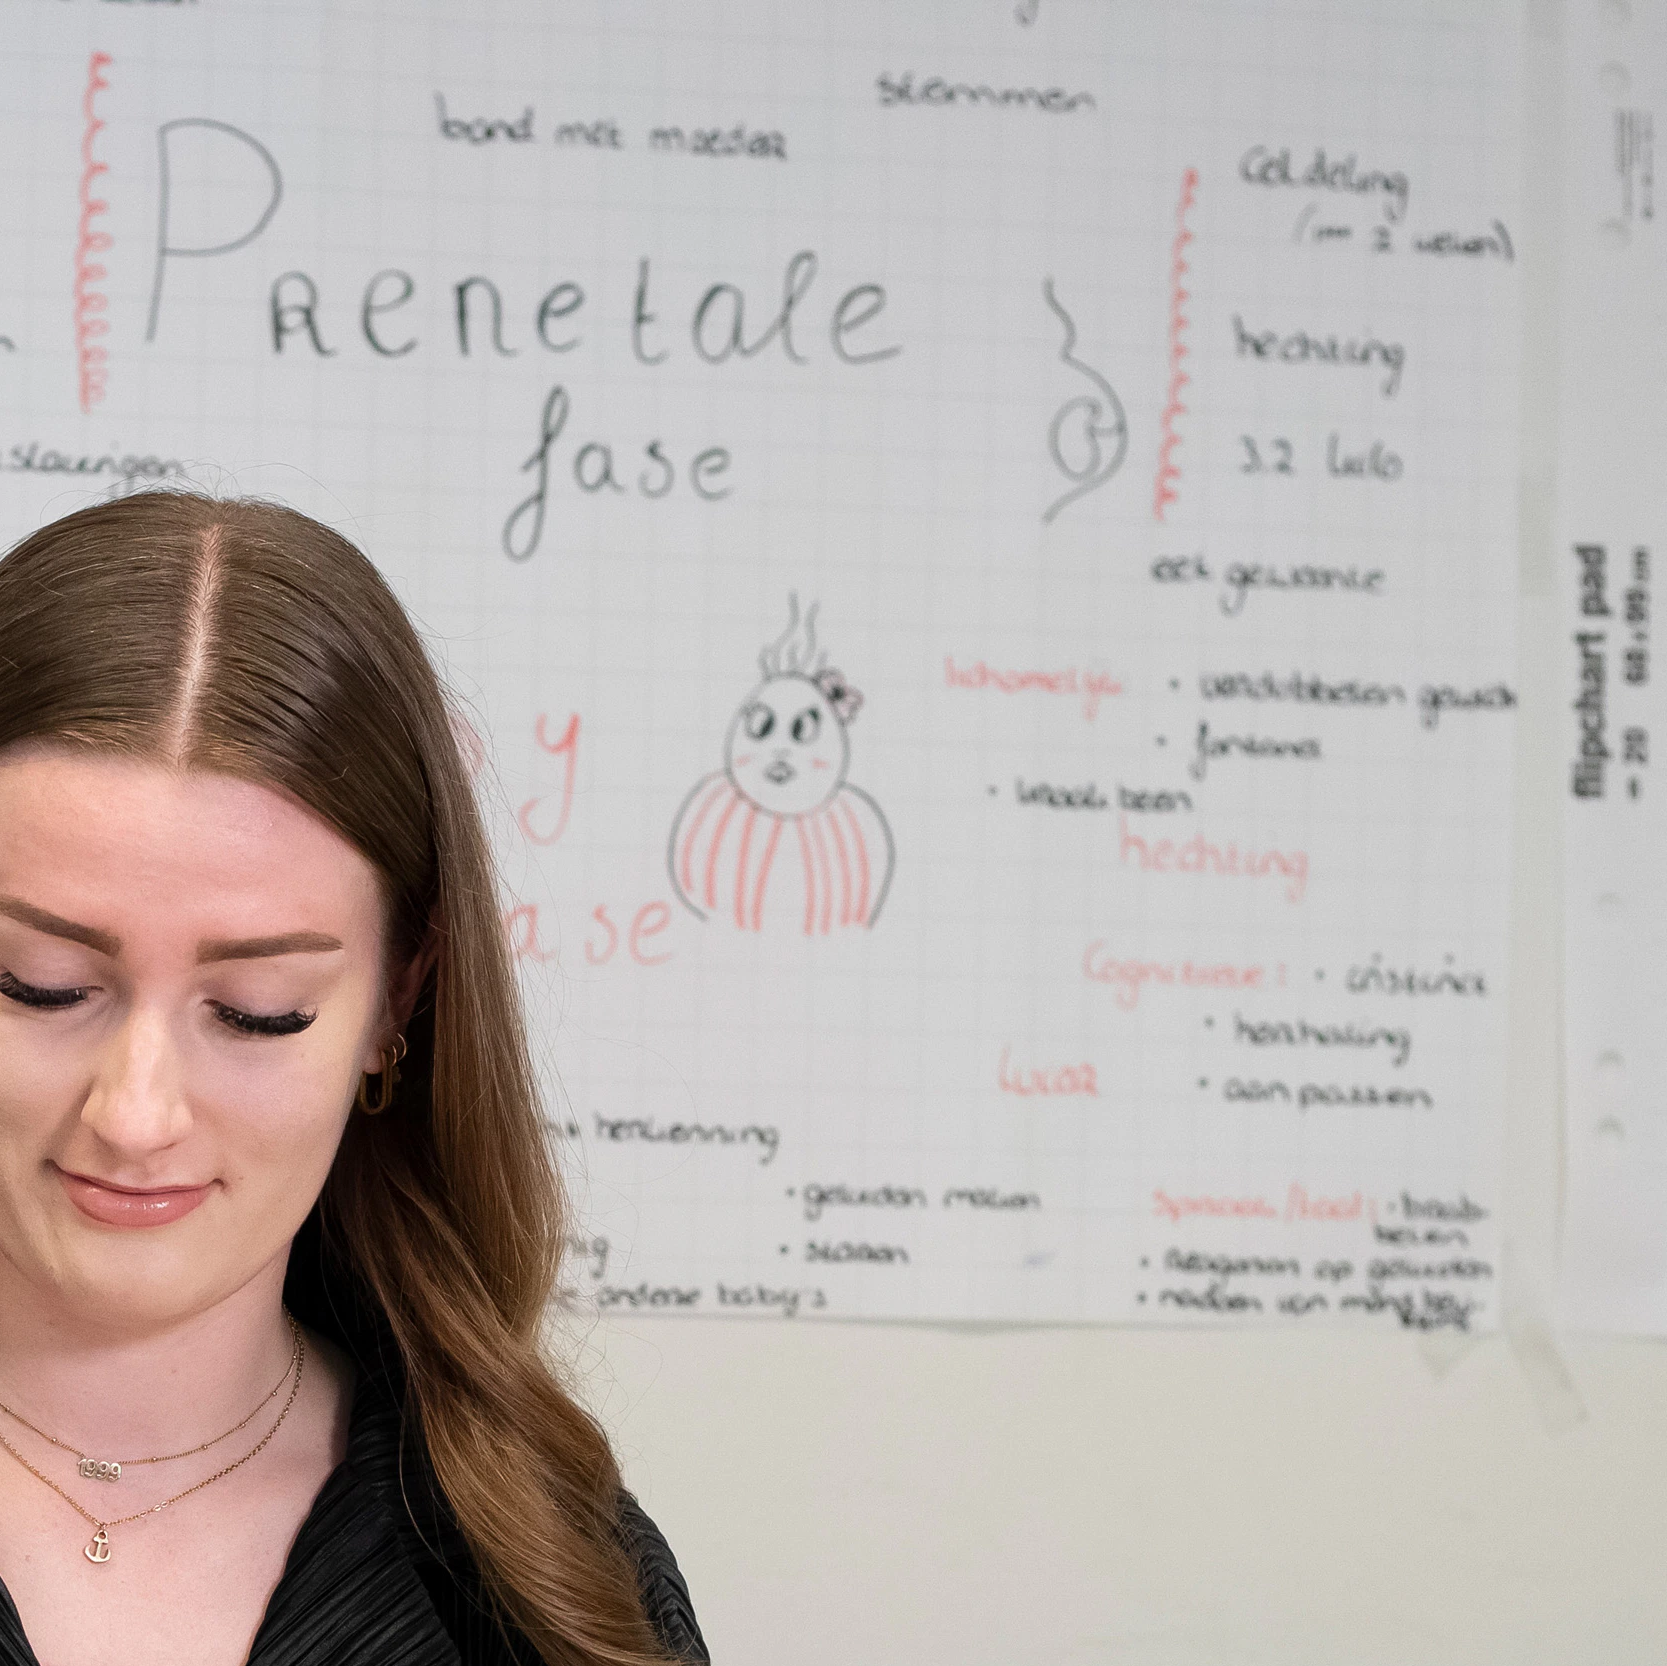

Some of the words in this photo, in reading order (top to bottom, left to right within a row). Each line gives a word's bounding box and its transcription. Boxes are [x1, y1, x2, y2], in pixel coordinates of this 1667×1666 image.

[1573, 543, 1614, 619] pad
[1570, 630, 1613, 801] flipchart
[77, 1457, 123, 1482] 1999
